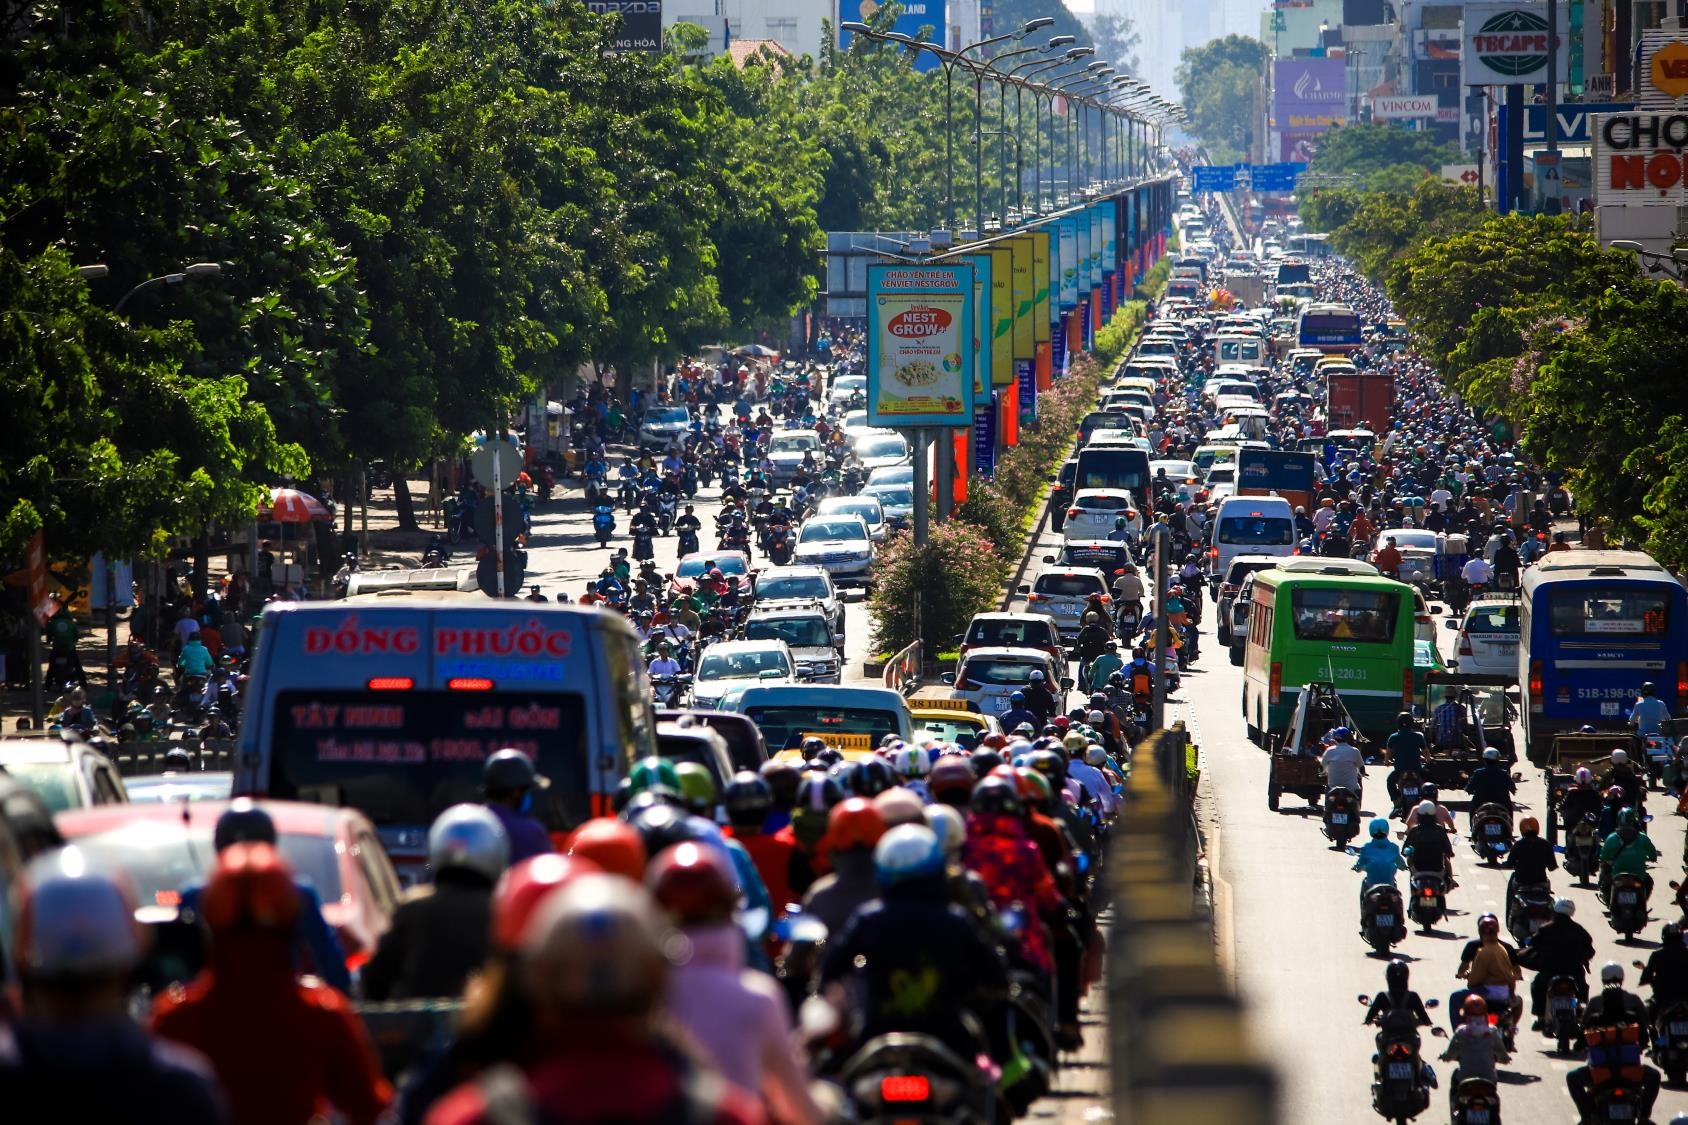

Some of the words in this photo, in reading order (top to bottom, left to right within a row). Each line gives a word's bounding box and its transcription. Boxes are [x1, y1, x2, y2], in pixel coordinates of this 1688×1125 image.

[1382, 101, 1432, 112] VINCOM
[915, 280, 959, 288] NESTGROW
[903, 313, 937, 322] NEST
